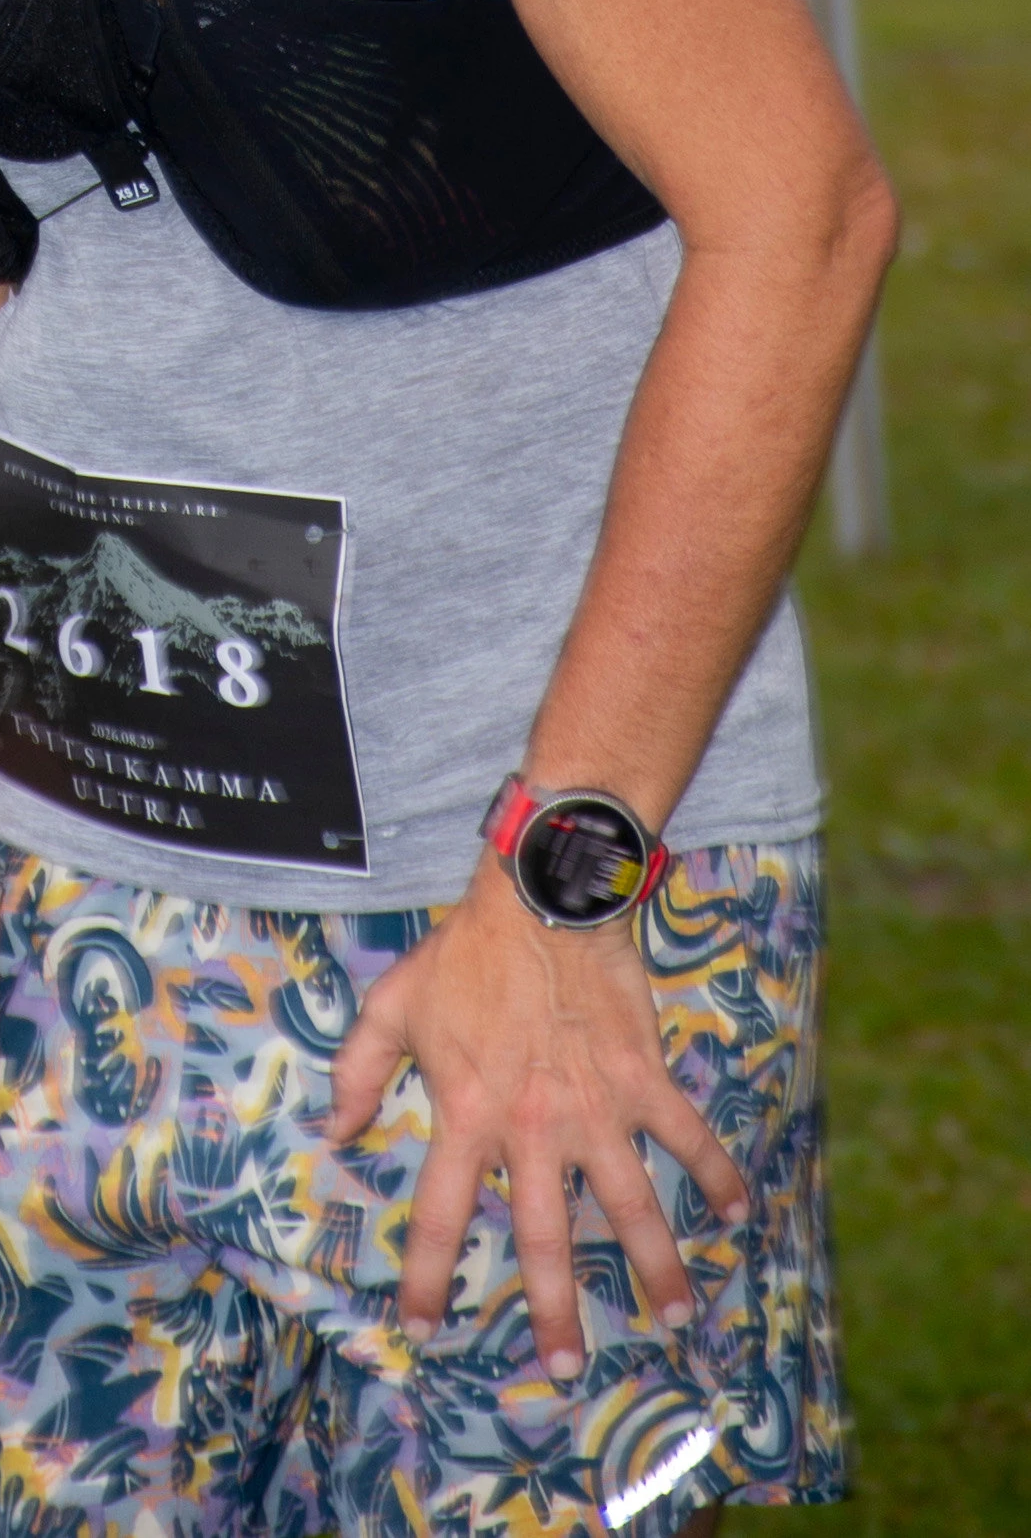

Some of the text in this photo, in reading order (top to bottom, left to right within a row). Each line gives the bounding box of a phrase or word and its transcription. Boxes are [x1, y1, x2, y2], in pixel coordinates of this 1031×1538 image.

[48, 498, 137, 527] CHEERING
[108, 495, 169, 513] TREES
[180, 503, 220, 518] ARE
[11, 712, 279, 804] TSITSIKAMMA
[72, 774, 195, 830] ULTRA
